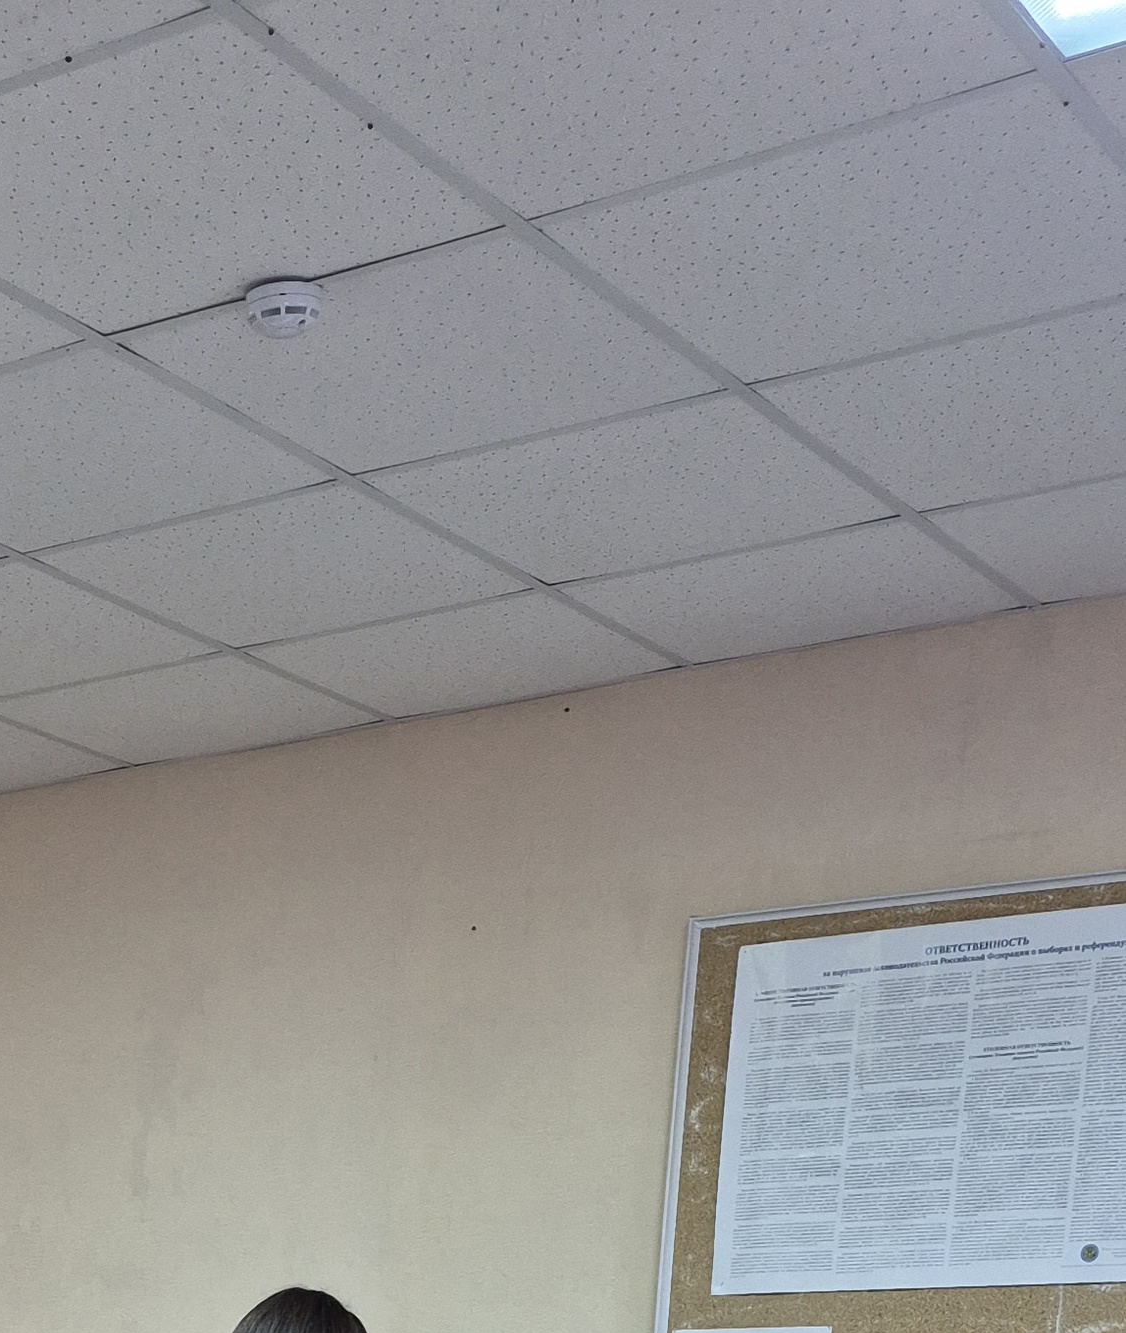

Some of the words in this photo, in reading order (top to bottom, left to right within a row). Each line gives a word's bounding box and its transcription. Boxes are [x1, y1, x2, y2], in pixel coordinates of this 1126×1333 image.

[925, 936, 1030, 956] ОТВЕТСТВЕННОСТЬ
[940, 953, 985, 966] Российской
[1081, 939, 1126, 953] референду
